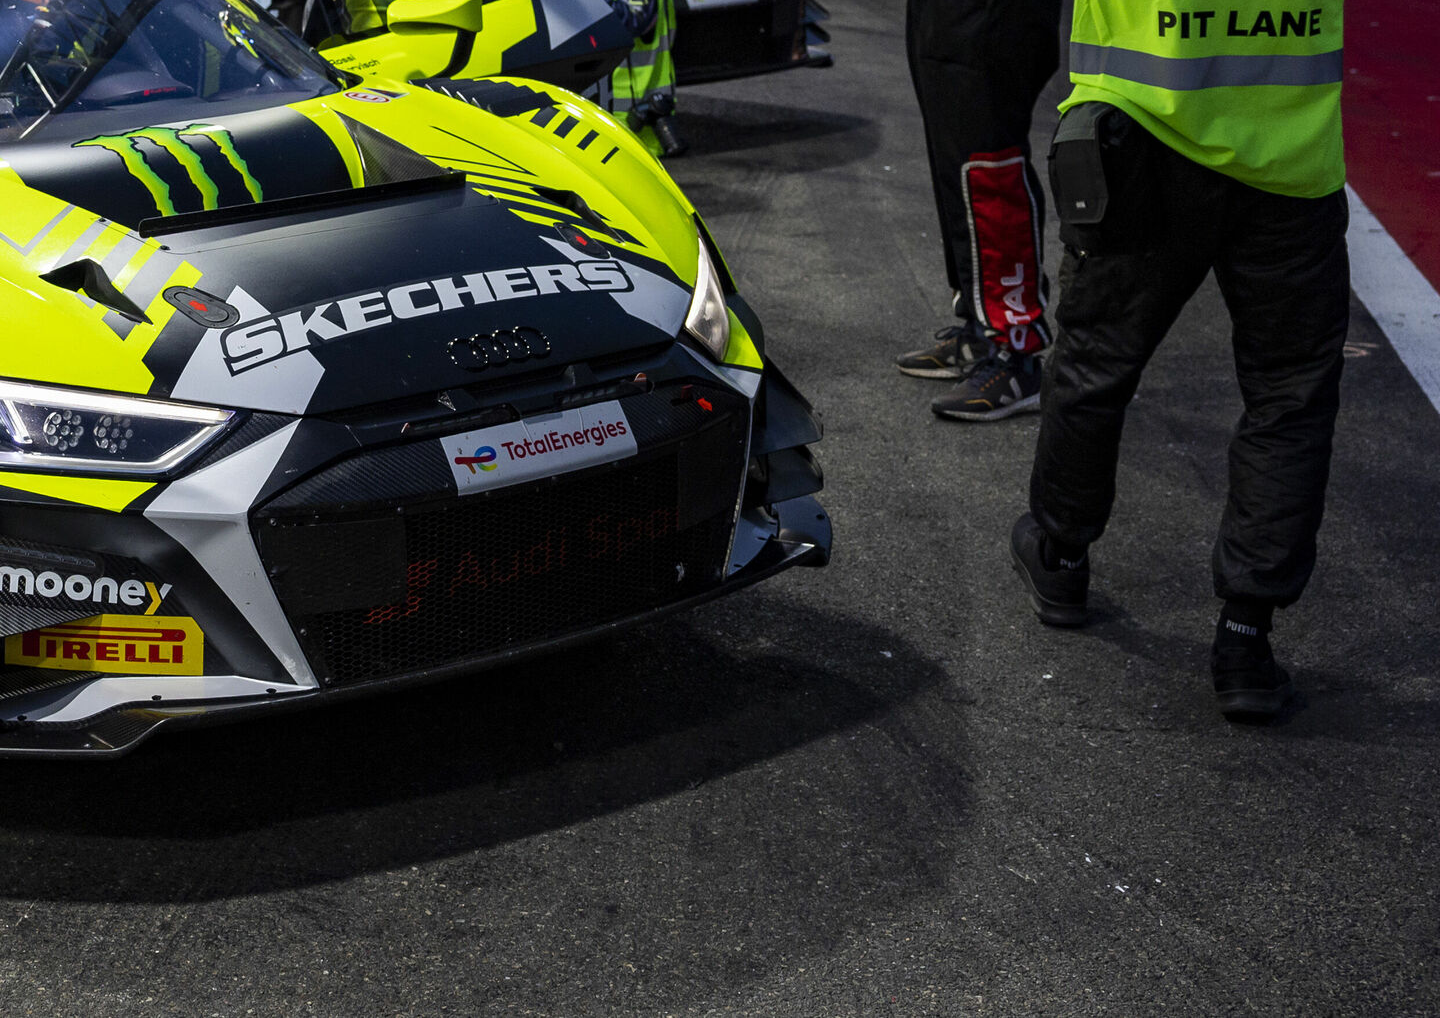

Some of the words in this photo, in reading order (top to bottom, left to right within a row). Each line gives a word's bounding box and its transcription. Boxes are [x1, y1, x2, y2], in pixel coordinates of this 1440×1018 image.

[1157, 10, 1216, 39] PIT
[1226, 7, 1323, 38] LANE
[222, 260, 632, 370] SKECHERS
[500, 415, 628, 462] TotalEnergies
[21, 627, 189, 664] PIRELLI
[1224, 618, 1258, 637] PUMA
